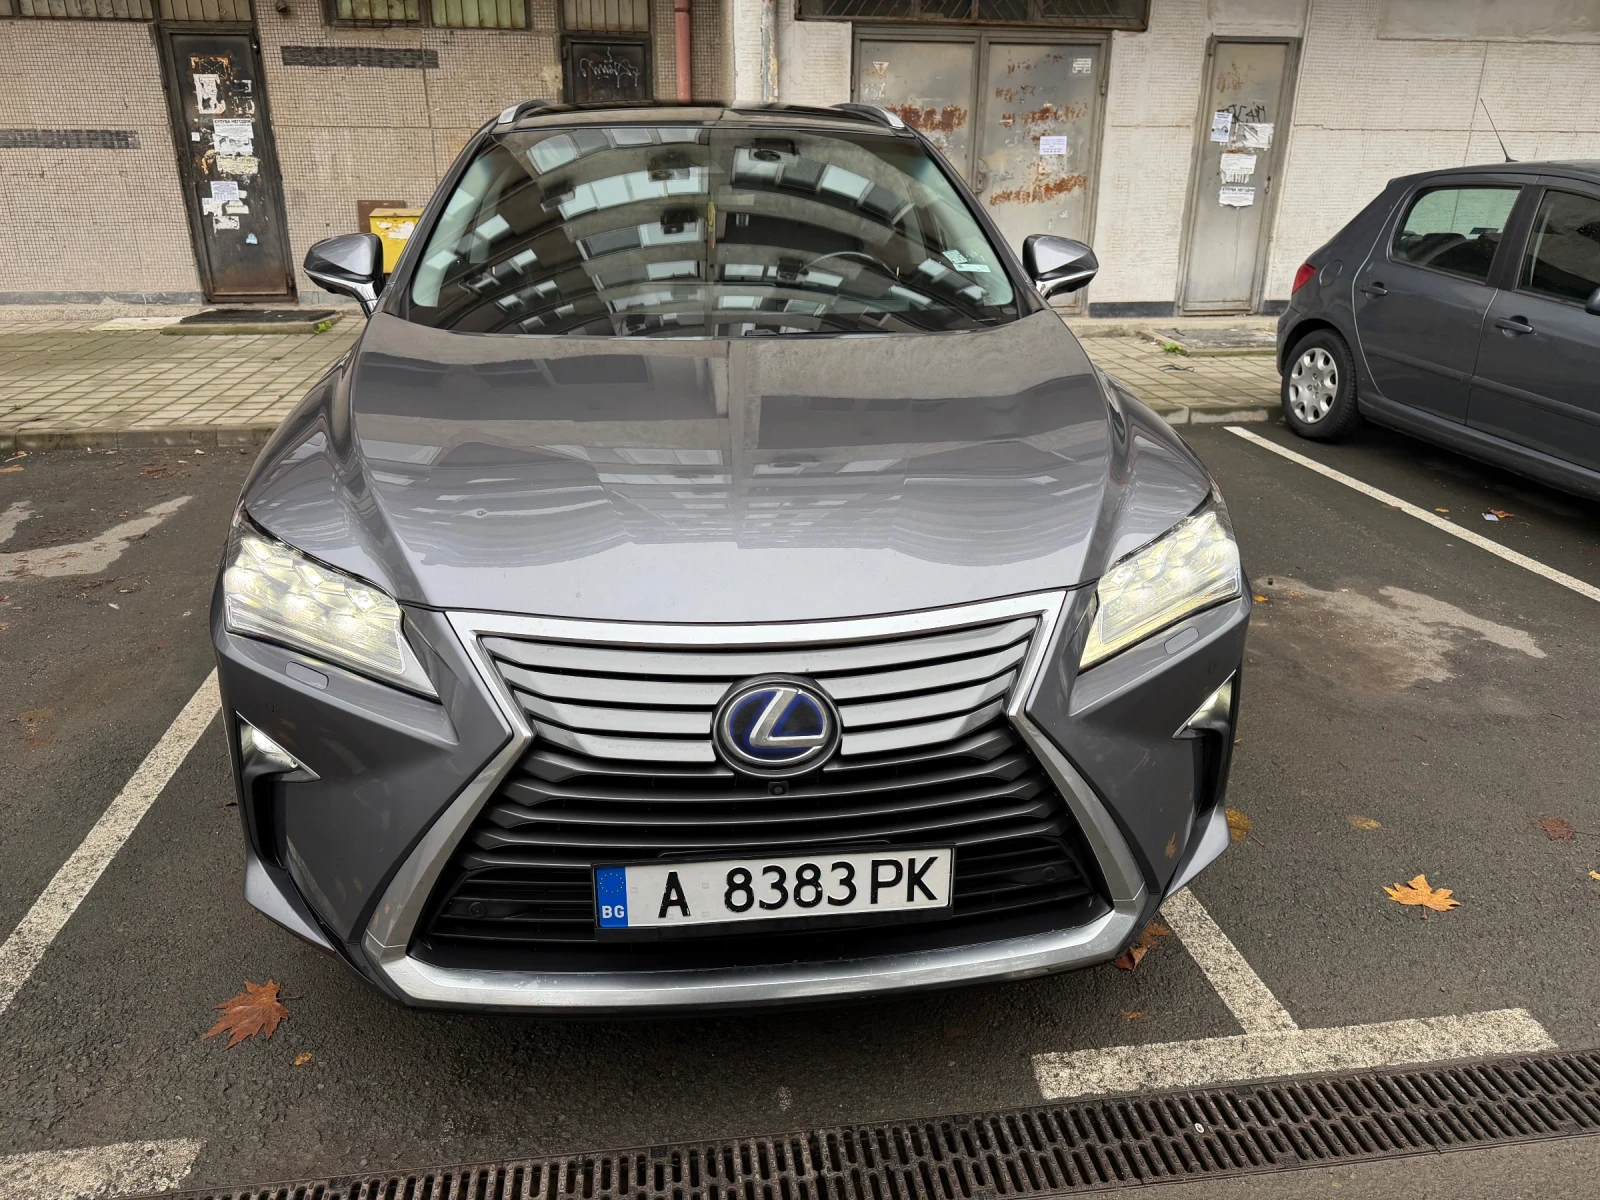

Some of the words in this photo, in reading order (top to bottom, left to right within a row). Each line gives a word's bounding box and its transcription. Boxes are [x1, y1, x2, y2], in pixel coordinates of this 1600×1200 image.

[658, 871, 691, 918] A
[724, 861, 857, 913] 8383
[870, 856, 938, 905] PK
[601, 904, 625, 919] BG
